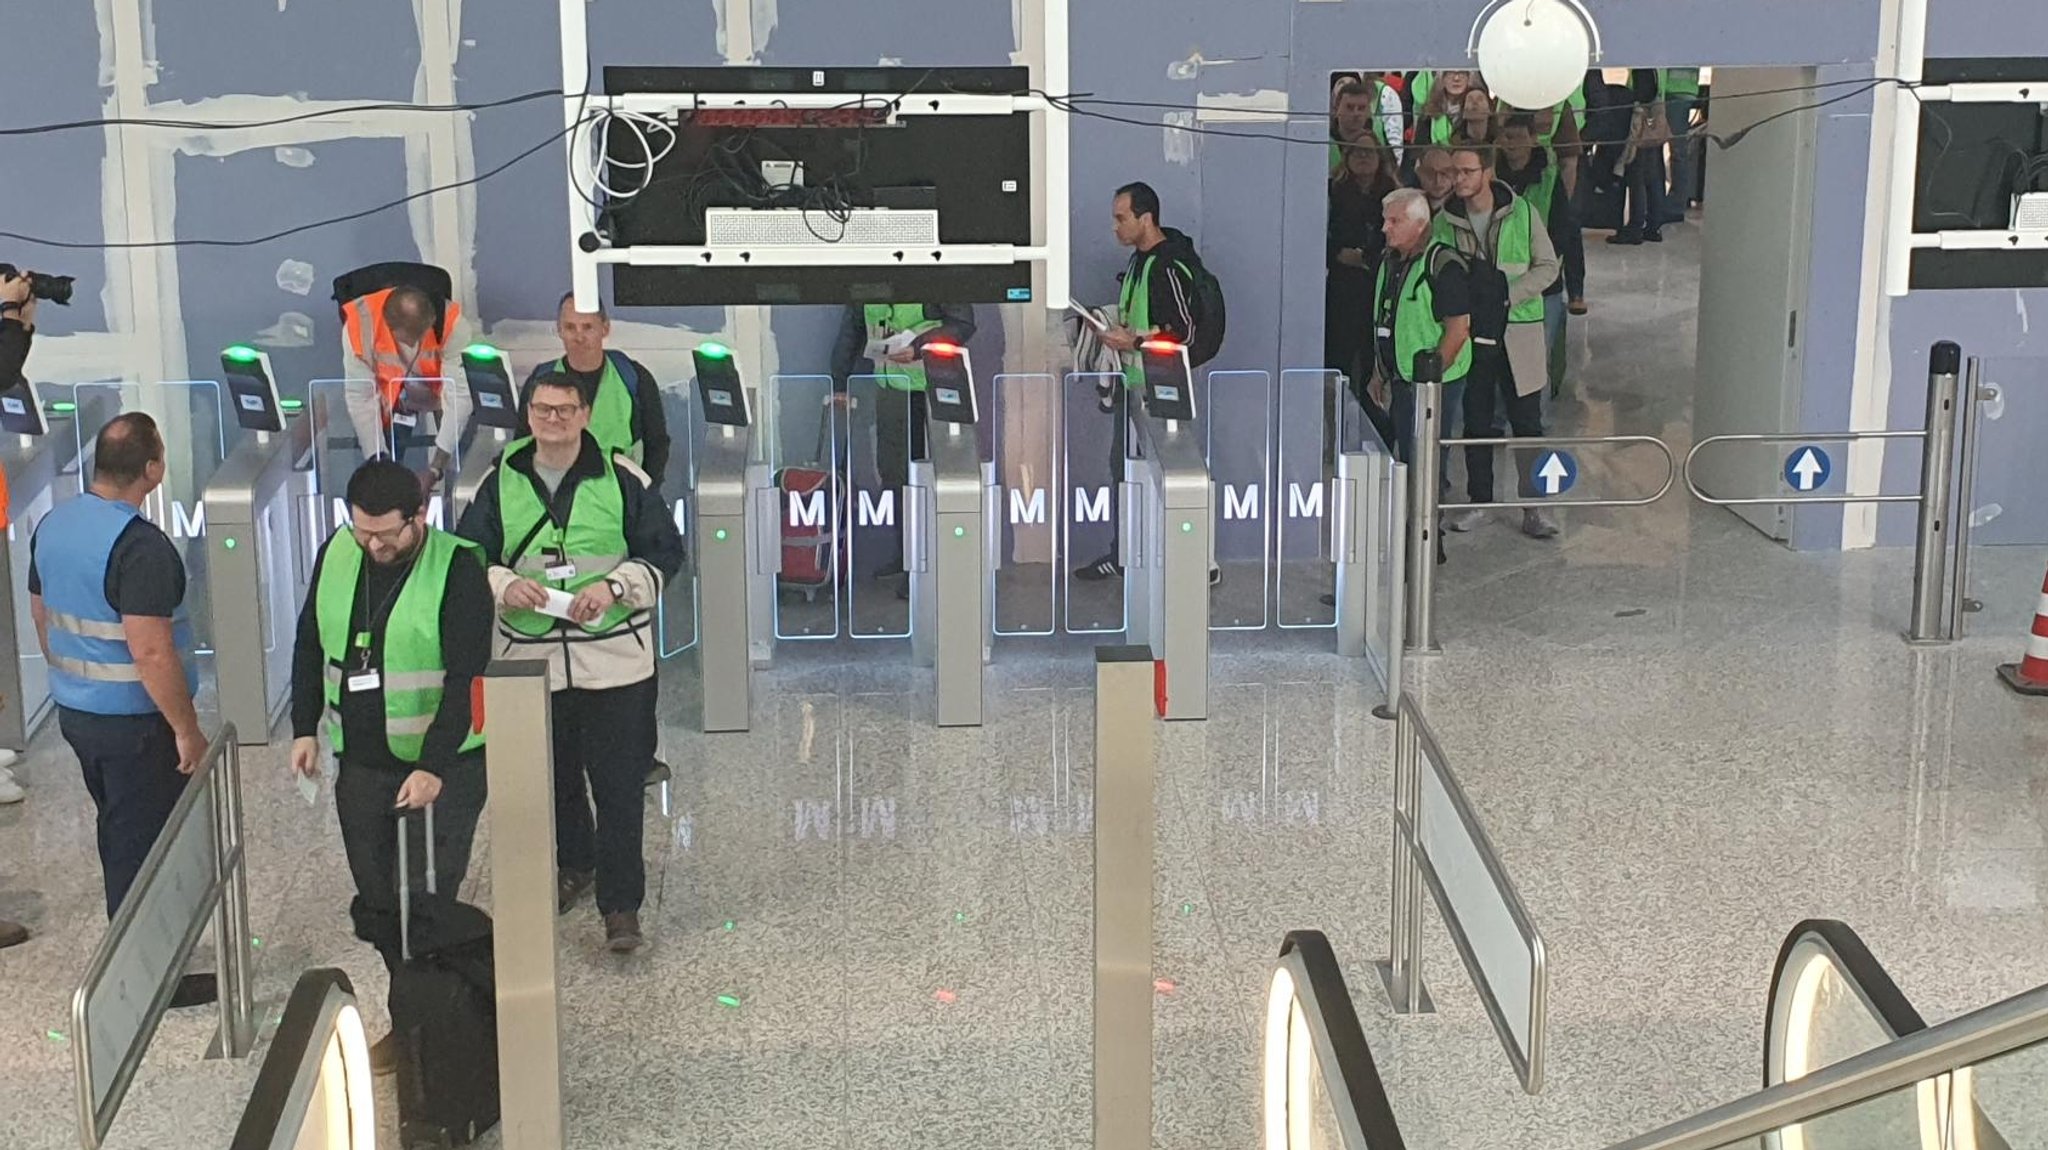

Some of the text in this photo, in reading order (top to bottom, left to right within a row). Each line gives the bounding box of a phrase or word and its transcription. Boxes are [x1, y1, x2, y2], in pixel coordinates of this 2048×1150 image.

[790, 490, 826, 526] M
[858, 490, 894, 526] M
[1010, 488, 1045, 524] M
[1075, 486, 1110, 522] M
[1223, 484, 1258, 520] M
[1289, 482, 1323, 519] M
[171, 500, 207, 538] M
